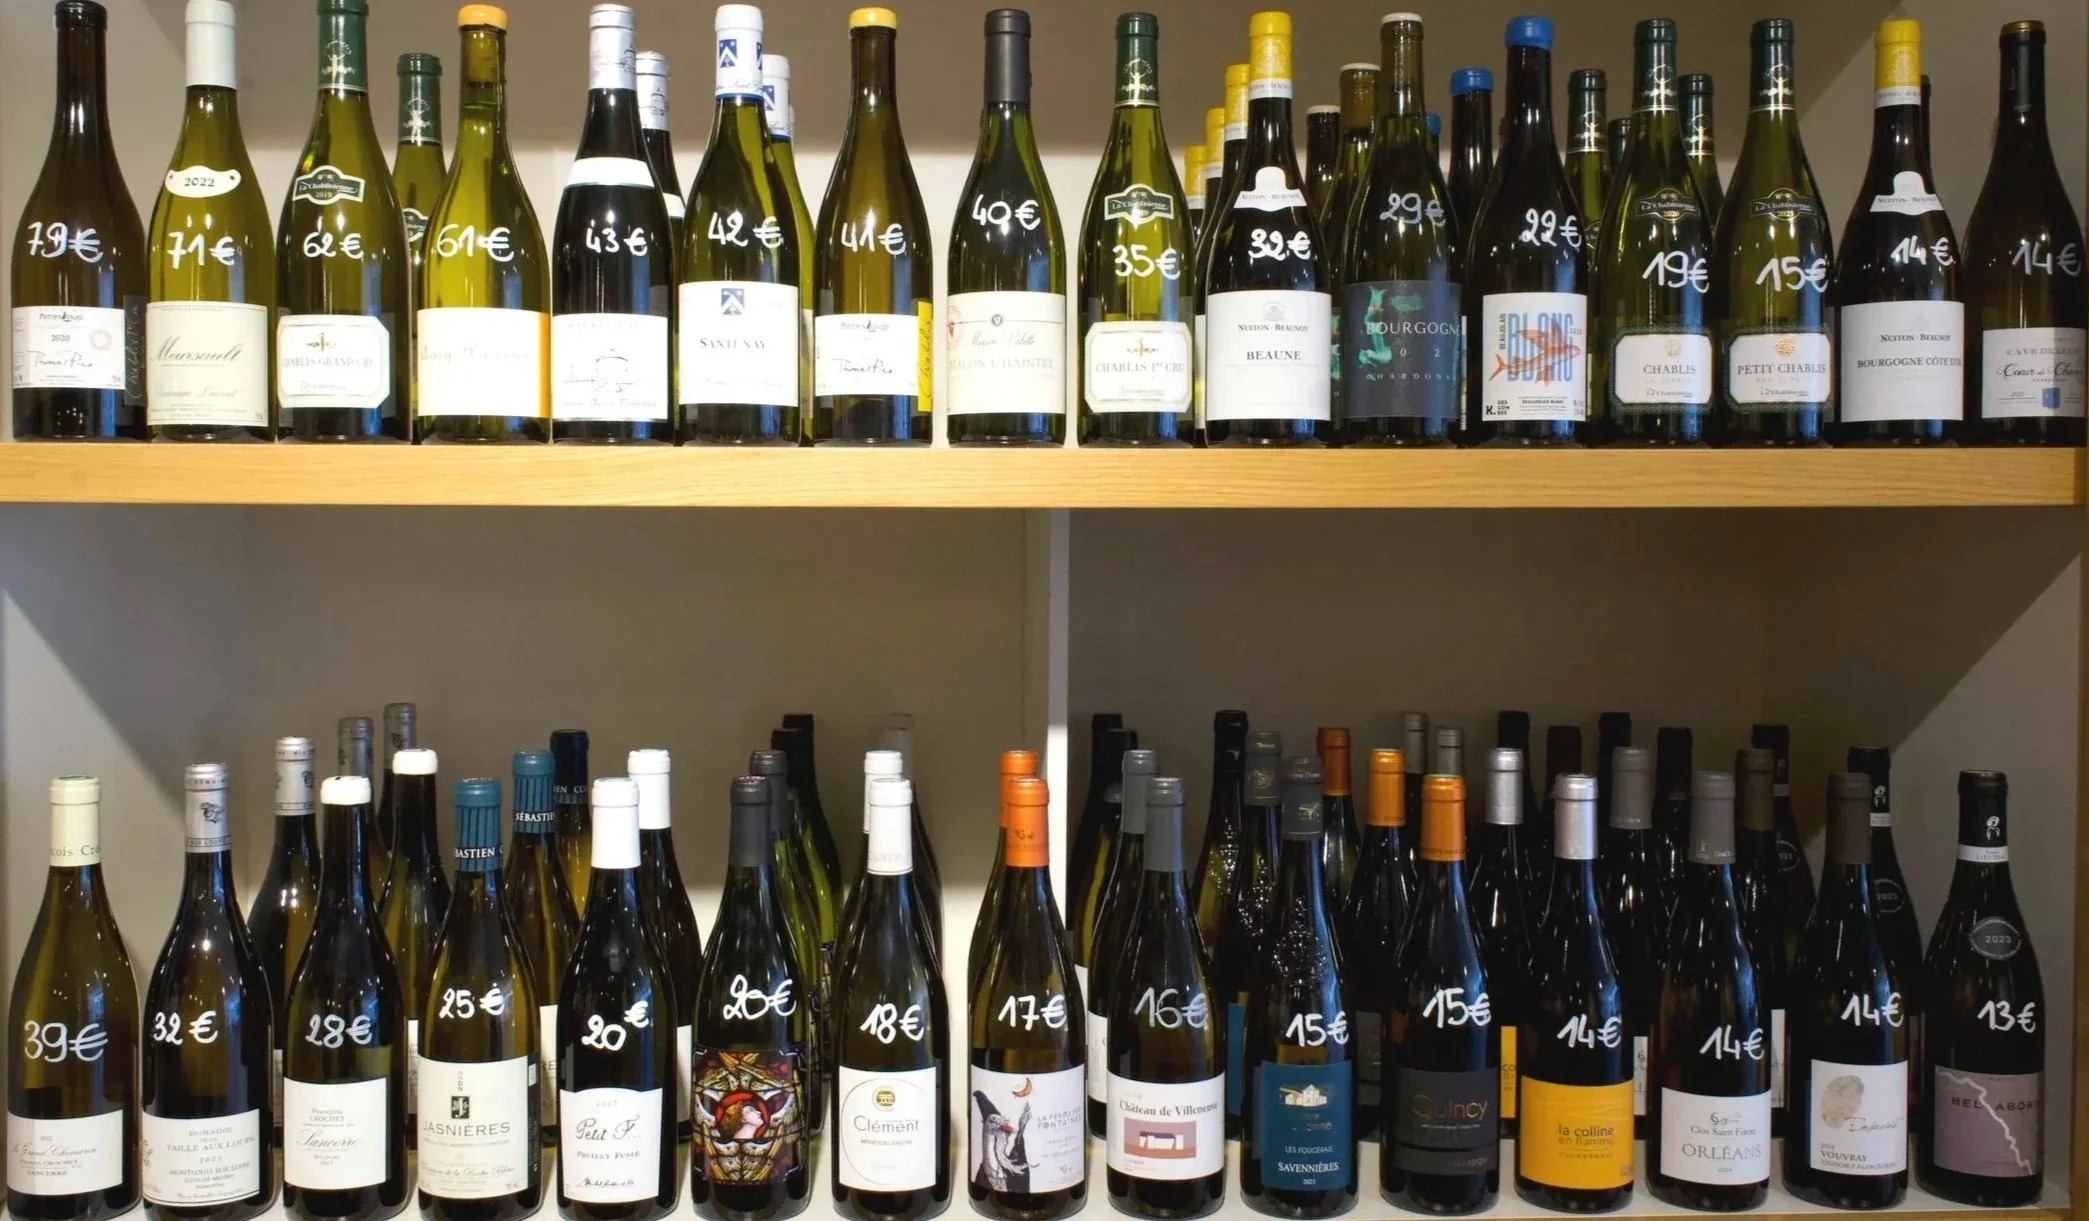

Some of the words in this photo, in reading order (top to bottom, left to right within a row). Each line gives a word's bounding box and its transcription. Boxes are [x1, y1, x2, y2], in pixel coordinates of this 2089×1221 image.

[184, 178, 214, 187] 2022
[972, 194, 1042, 231] 40€
[1380, 192, 1446, 228] 29€
[27, 221, 104, 264] 79€
[437, 223, 514, 262] 61€
[586, 226, 649, 258] 43€
[840, 220, 907, 256] 41€
[1248, 228, 1312, 261] 32€
[1519, 208, 1582, 248] 22€
[167, 231, 237, 270] 71€
[303, 231, 365, 260] 62€
[1112, 244, 1181, 280] 35€
[1890, 235, 1954, 267] 14€
[2012, 241, 2081, 278] 14€
[1642, 250, 1710, 294] 19€
[1755, 256, 1828, 294] 15€
[51, 334, 70, 342] 2020
[153, 336, 243, 362] Meursault
[1506, 313, 1573, 382] BLANC
[1095, 362, 1148, 373] CHABLIS
[1246, 350, 1302, 361] BEAUNE
[1643, 364, 1696, 375] CHABLIS
[1736, 364, 1773, 375] PETIT
[1777, 363, 1827, 374] CHABLIS
[1857, 357, 1924, 368] BOURGOGNE
[1984, 935, 2012, 944] 2023
[438, 986, 505, 1020] 25€
[723, 974, 797, 1022] 20€
[998, 994, 1067, 1031] 17€
[1135, 986, 1209, 1030] 16€
[1422, 987, 1492, 1029] 15€
[1841, 991, 1904, 1028] 14€
[304, 1013, 373, 1050] 28€
[859, 1003, 925, 1044] 18€
[1285, 1011, 1350, 1048] 15€
[1557, 1013, 1622, 1050] 14€
[1977, 1000, 2037, 1034] 13€
[24, 1020, 108, 1063] 39€
[1700, 1024, 1766, 1062] 14€
[853, 1114, 919, 1133] Clément
[1119, 1099, 1157, 1116] Château
[1160, 1106, 1172, 1117] de
[167, 1143, 200, 1152] TAILLE
[202, 1142, 225, 1152] AUX
[226, 1136, 255, 1148] LOUPS
[188, 1126, 233, 1137] DOMAINE
[423, 1121, 511, 1137] JASNIÈRES
[576, 1118, 607, 1141] Petit
[1558, 1124, 1569, 1136] la
[1574, 1125, 1615, 1137] colline
[1690, 1124, 1710, 1135] Clos
[1712, 1126, 1733, 1136] Saint
[577, 1150, 612, 1159] POUILLY
[1278, 1161, 1340, 1173] SAVENNIÈRES
[1681, 1143, 1763, 1160] ORLÉANS
[1820, 1150, 1868, 1163] VOUVRAY
